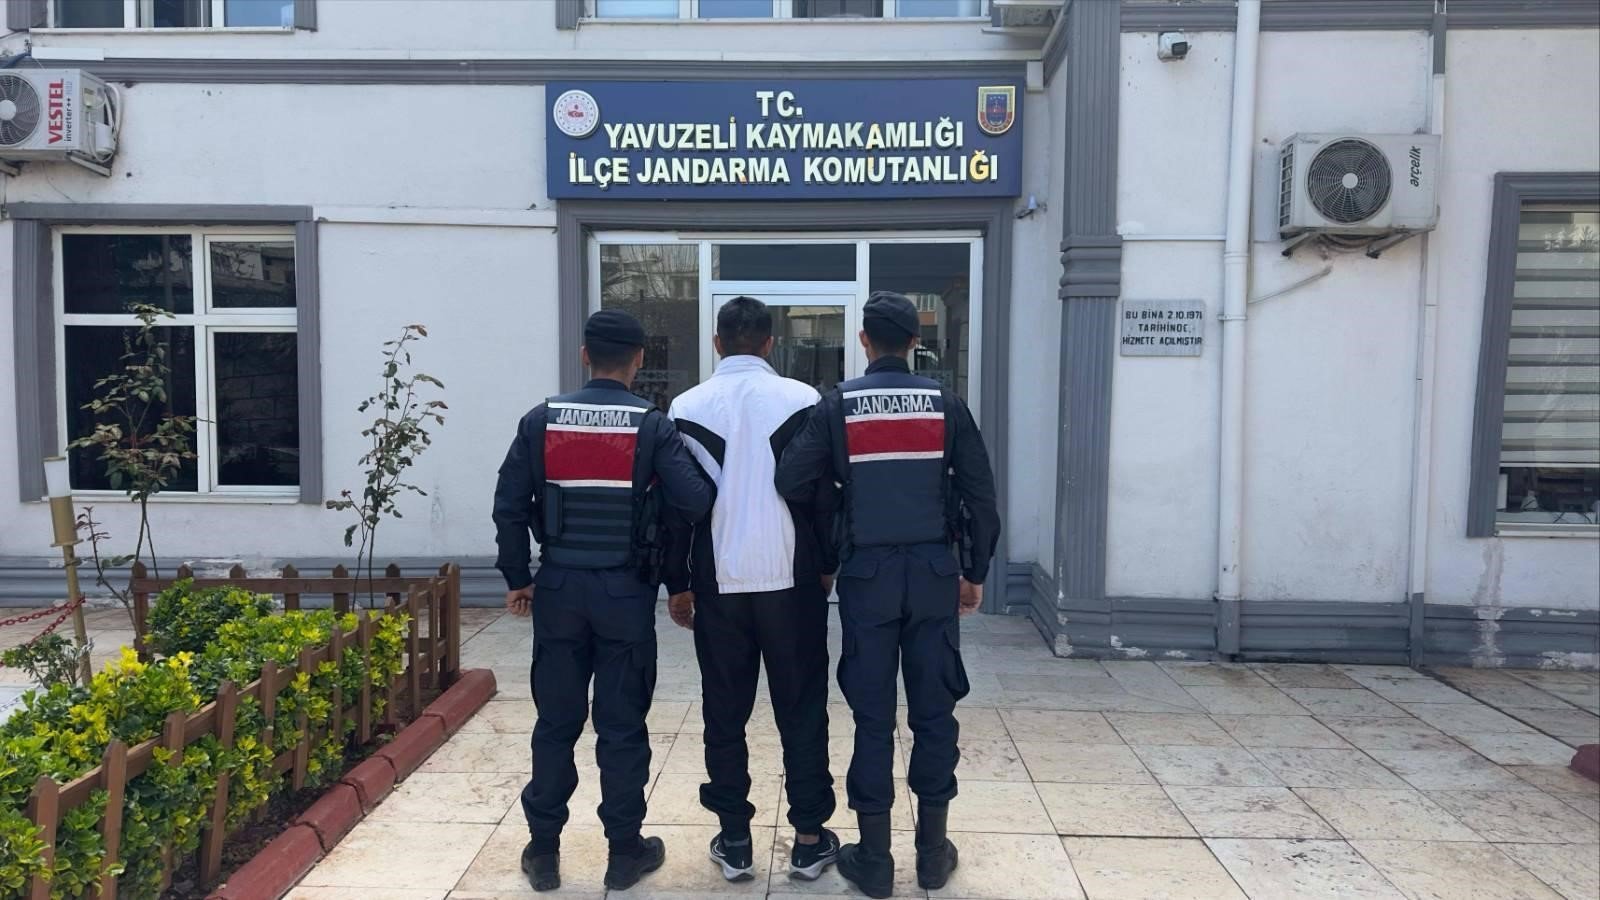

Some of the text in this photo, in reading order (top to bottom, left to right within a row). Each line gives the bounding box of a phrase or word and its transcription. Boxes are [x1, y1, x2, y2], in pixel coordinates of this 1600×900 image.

[48, 78, 64, 144] VESTEL
[604, 116, 737, 149] YAVUZELİ
[746, 116, 964, 149] KAYMAKAMLIĞI
[569, 150, 998, 188] İLÇE JANDARMA KOMUTANLIĞI
[1409, 146, 1421, 187] arçelik
[1125, 310, 1138, 319] BU
[1141, 309, 1164, 319] BİNA
[1122, 334, 1155, 345] HİZMETE
[556, 408, 631, 427] JANDARMA
[852, 395, 934, 415] JANDARMA
